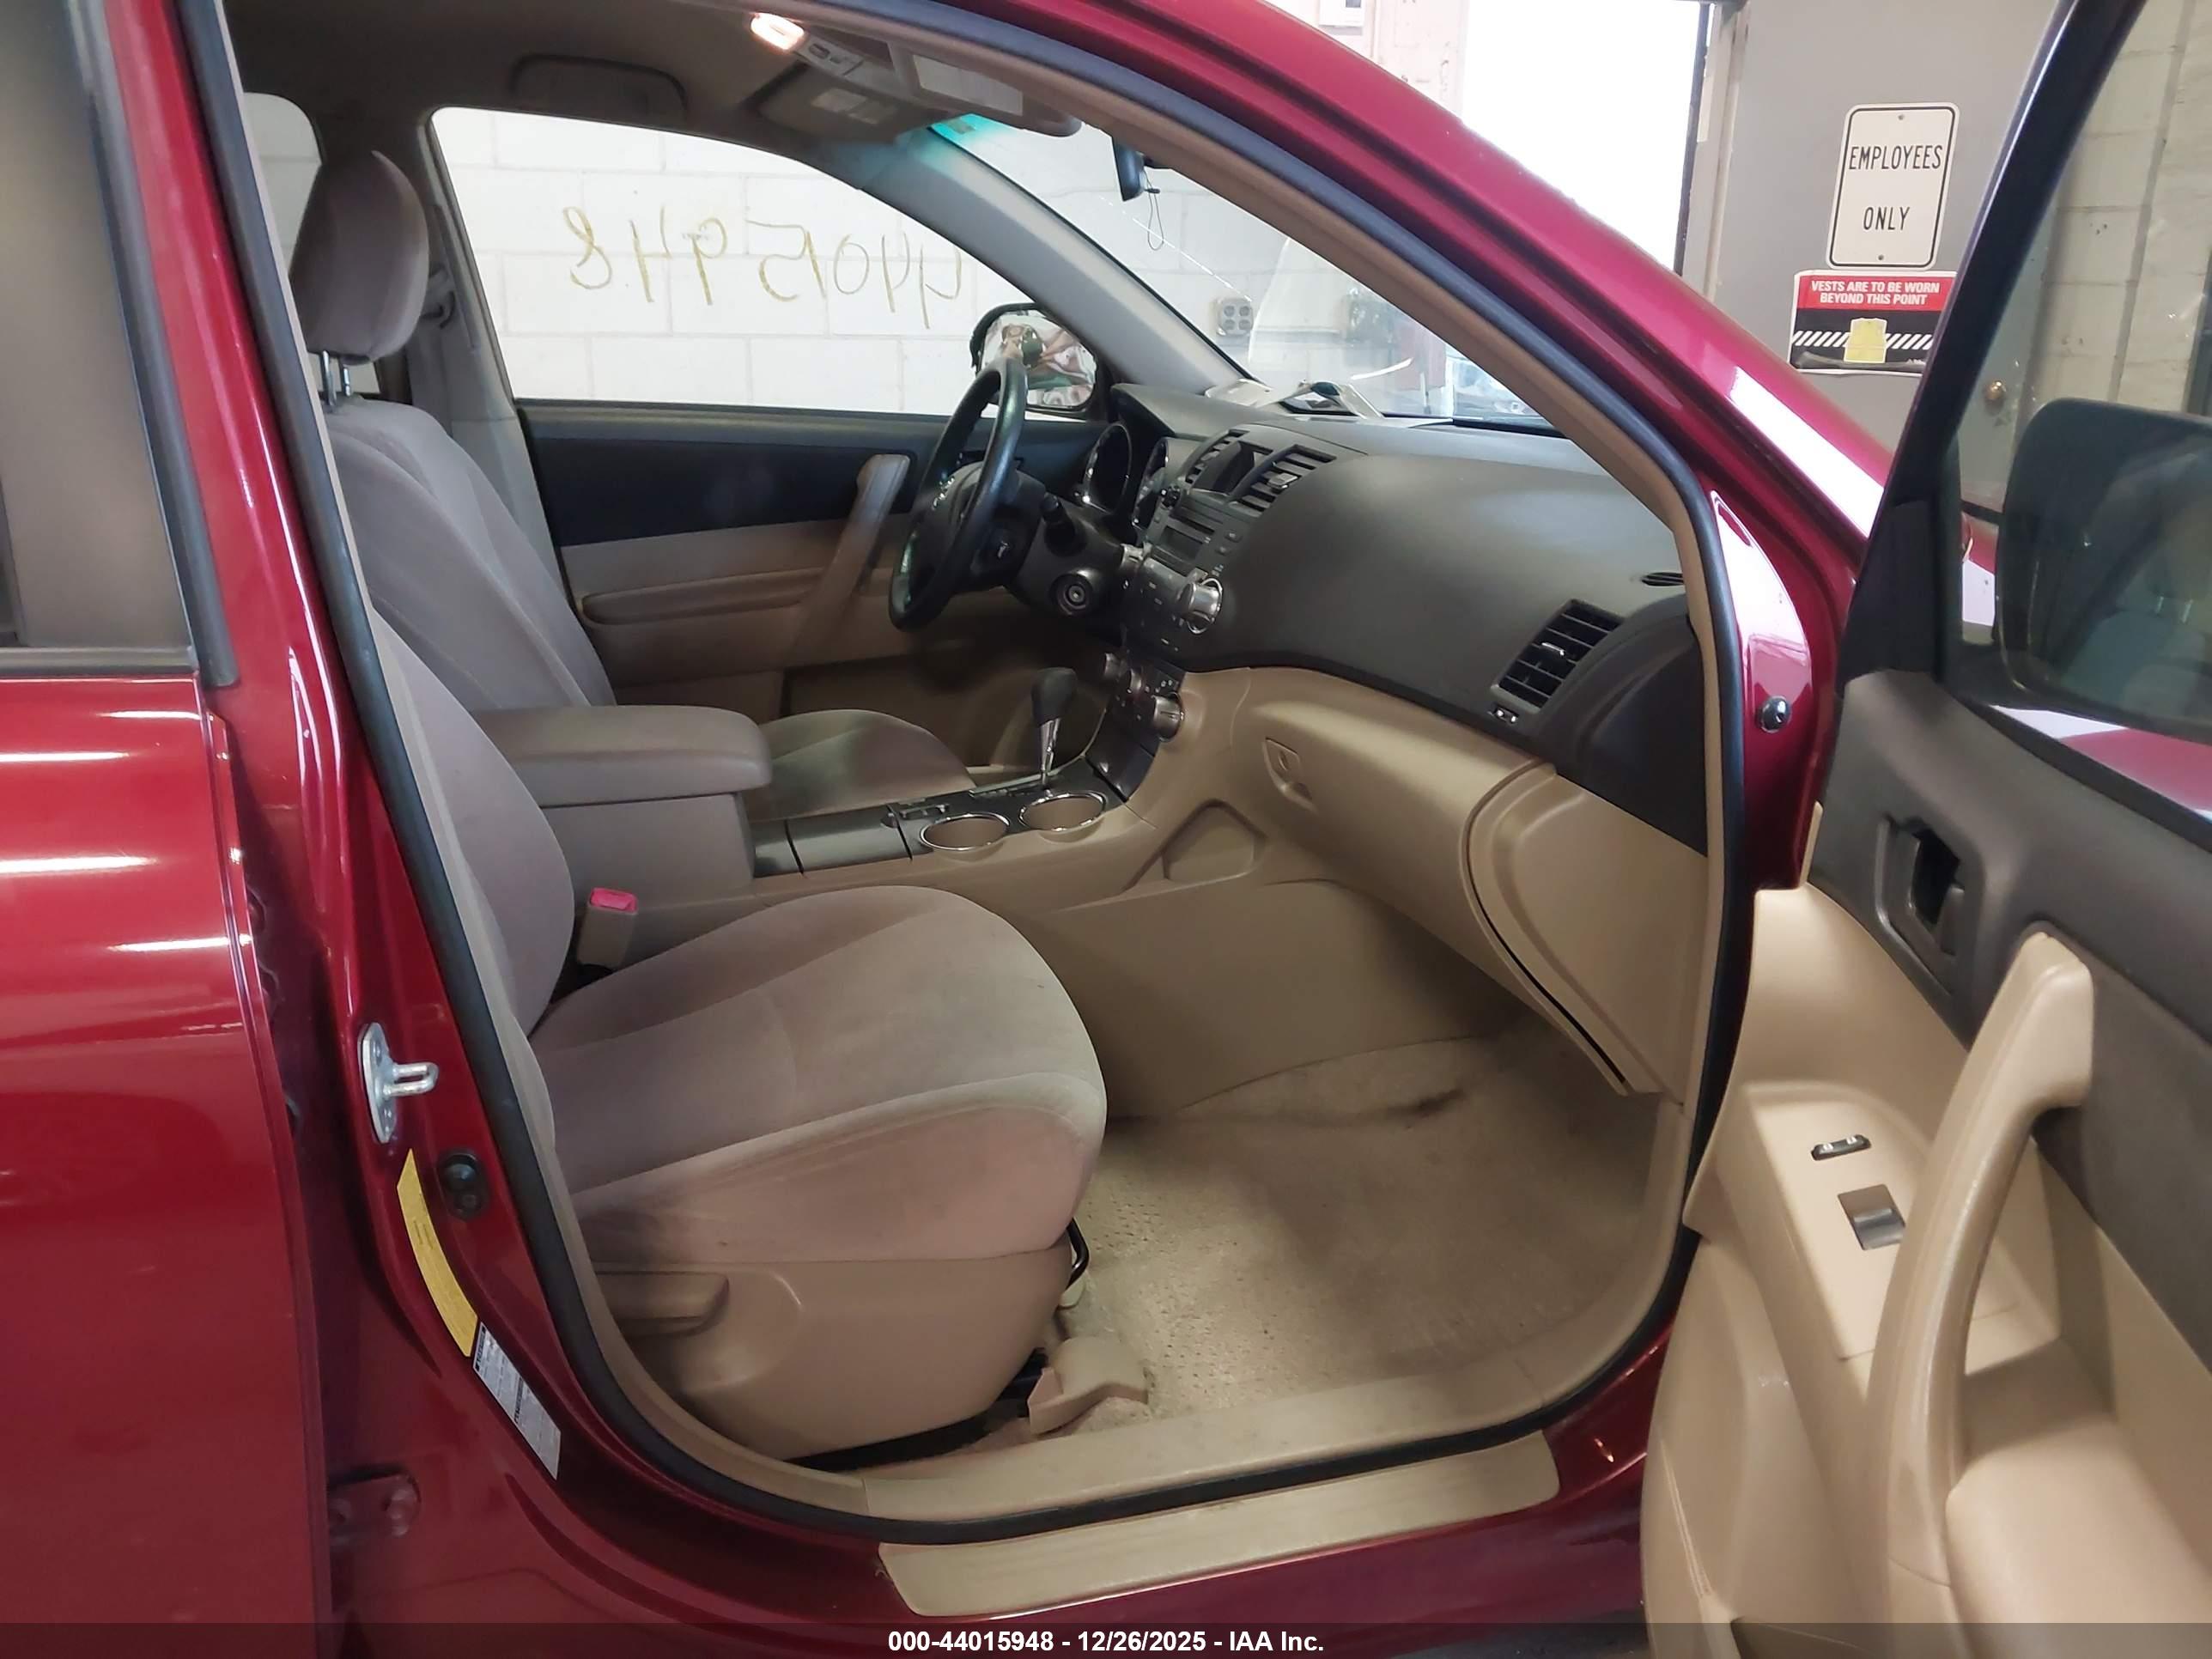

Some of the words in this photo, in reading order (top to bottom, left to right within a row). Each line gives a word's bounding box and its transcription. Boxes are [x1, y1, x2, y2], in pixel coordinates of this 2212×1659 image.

[1848, 144, 1943, 170] EMPLOYEES
[1863, 206, 1911, 231] ONLY
[1811, 280, 1844, 292] VESTS
[1847, 281, 1869, 292] ARE
[1871, 282, 1885, 293] TO
[1887, 282, 1901, 293] BE
[1905, 282, 1941, 294] WORN
[1820, 292, 1863, 303] BEYOND
[1867, 293, 1891, 304] THIS
[1893, 294, 1928, 305] POINT
